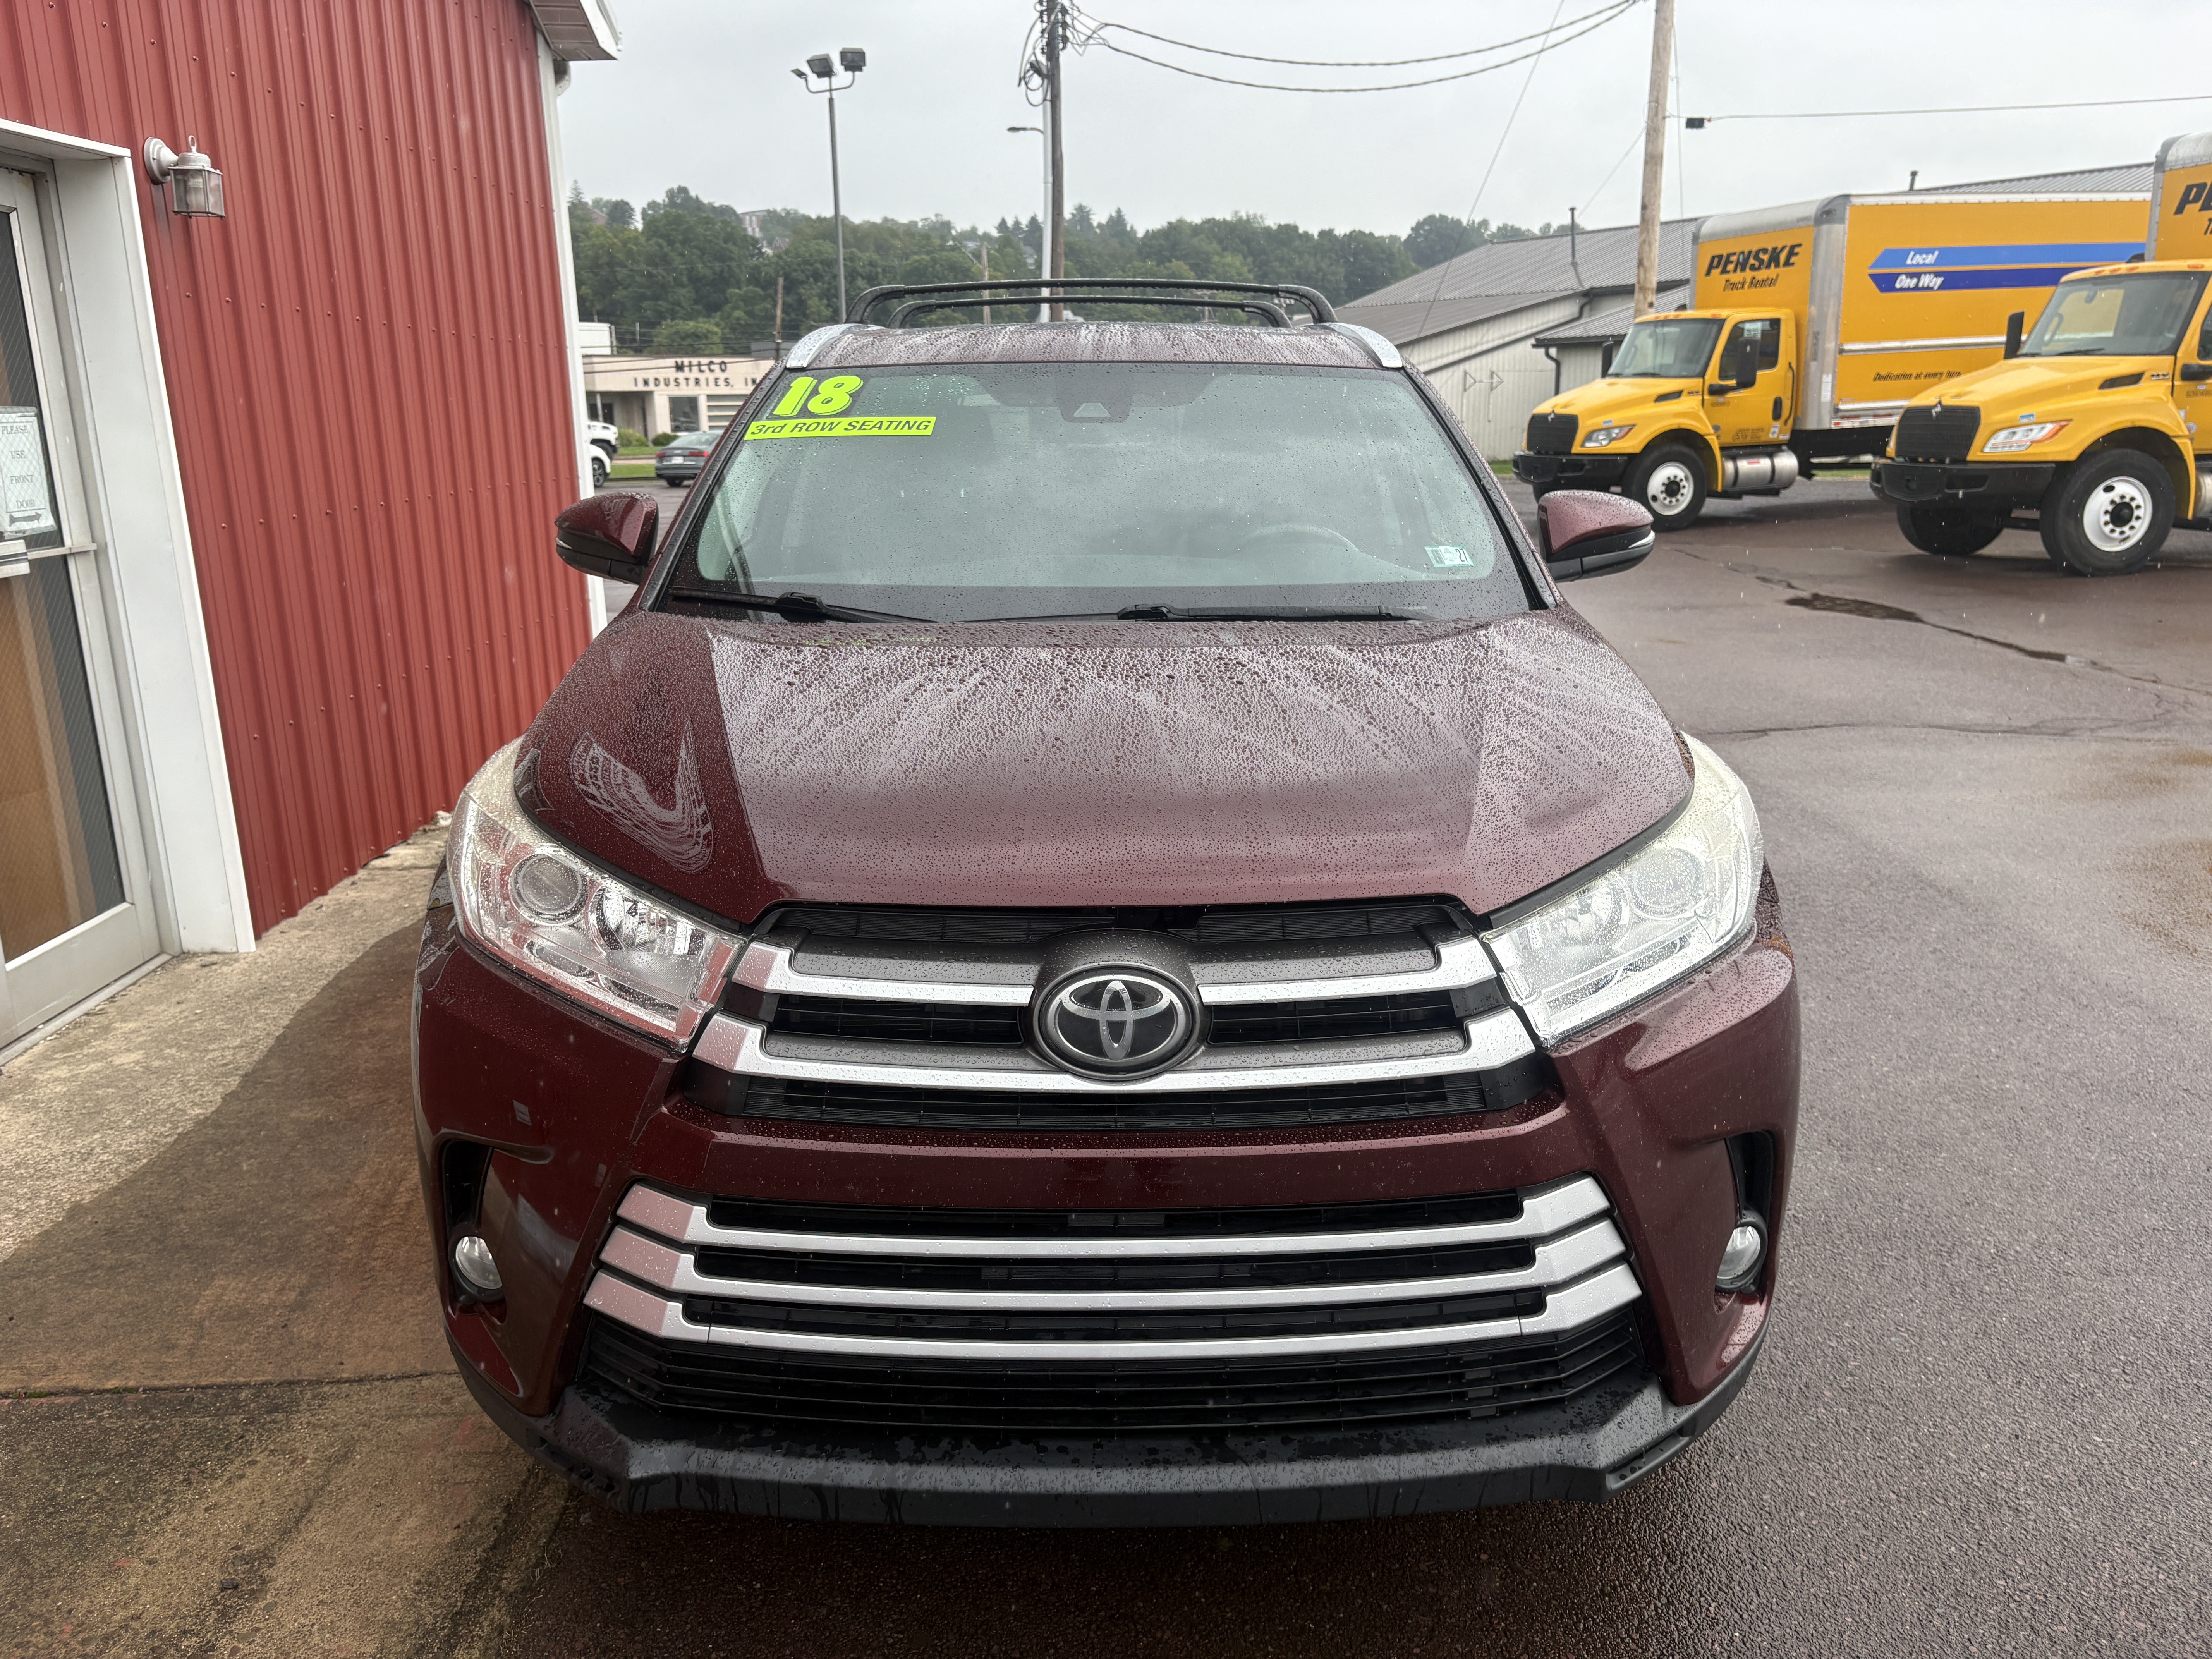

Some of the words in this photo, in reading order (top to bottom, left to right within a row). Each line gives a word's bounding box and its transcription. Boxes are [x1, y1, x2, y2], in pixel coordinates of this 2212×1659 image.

[1705, 244, 1802, 277] PENSKE
[1906, 250, 1939, 265] Local
[1723, 276, 1748, 292] Truck
[1748, 272, 1780, 289] Rental
[1895, 273, 1918, 289] One
[1918, 273, 1944, 290] Way
[675, 361, 727, 373] MILCO
[744, 378, 758, 386] IN
[773, 375, 864, 417] 18
[2, 425, 29, 434] PLEASE
[750, 423, 787, 435] 3rd
[790, 421, 842, 433] ROW
[844, 420, 932, 431] SEATING
[10, 450, 26, 459] USE
[10, 475, 34, 484] FRONT
[16, 499, 35, 508] DOOR
